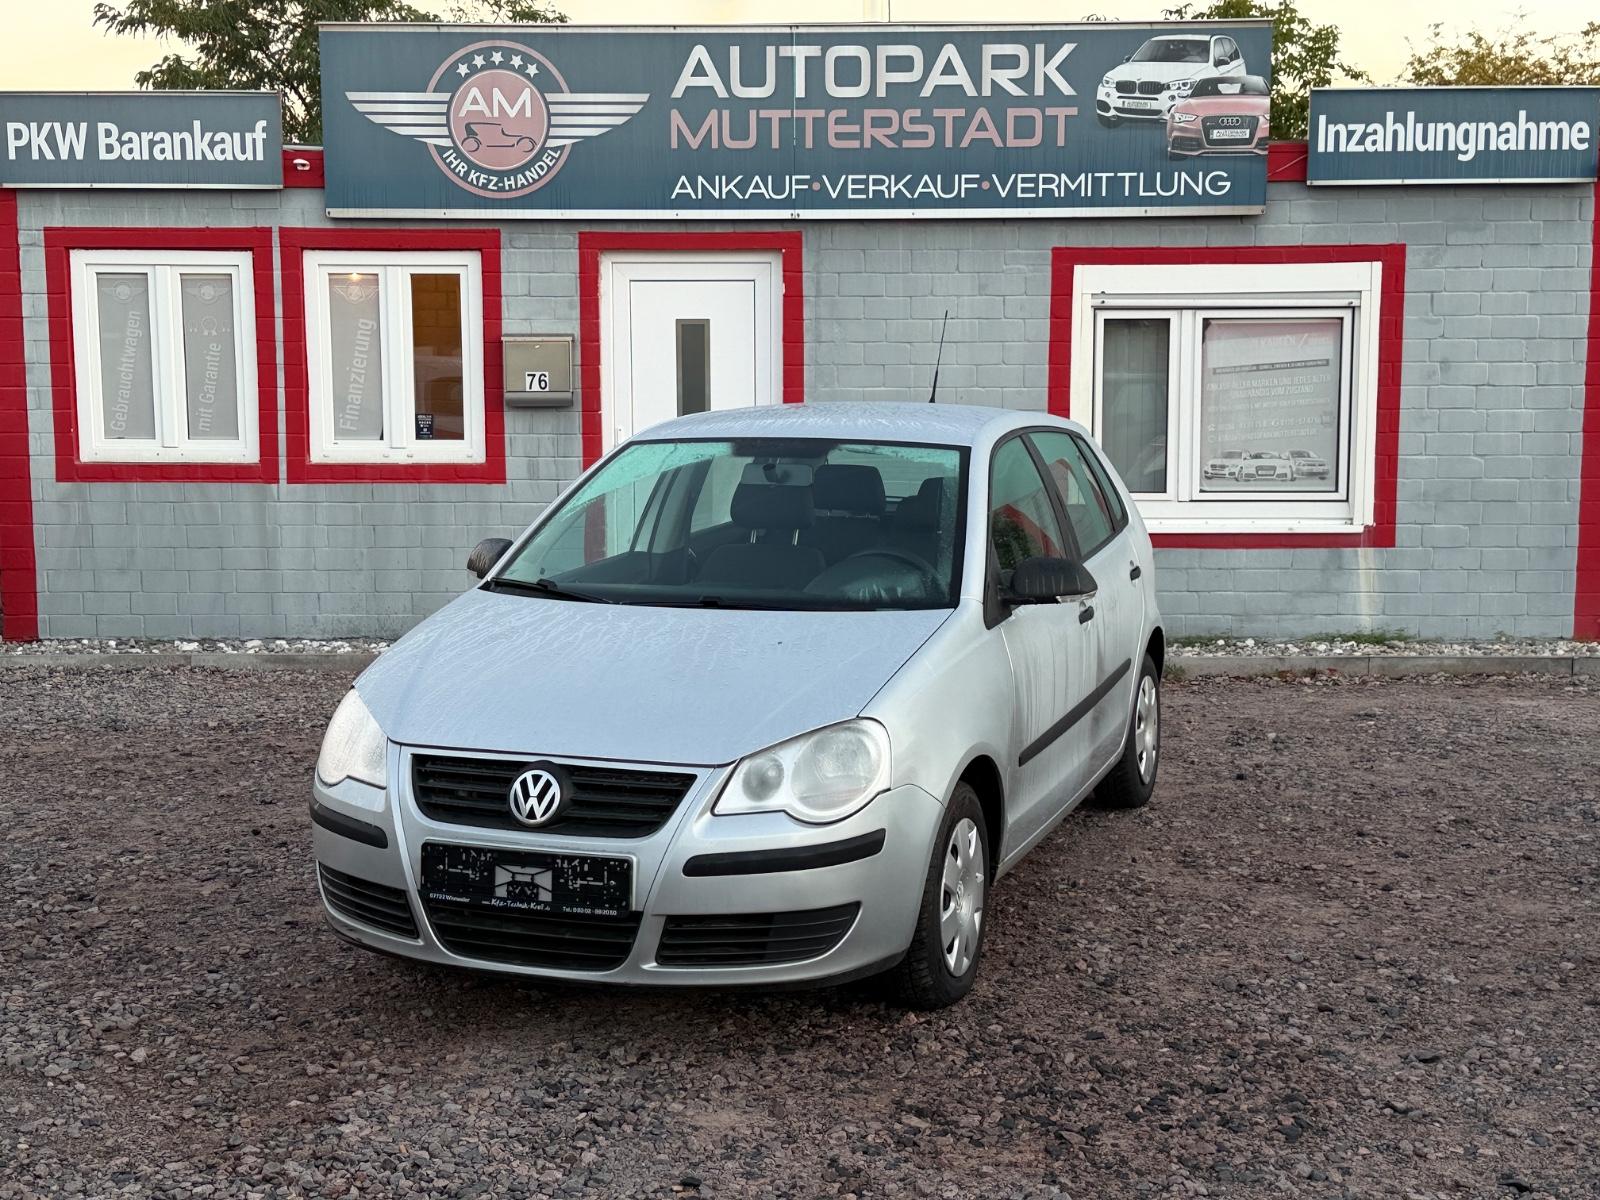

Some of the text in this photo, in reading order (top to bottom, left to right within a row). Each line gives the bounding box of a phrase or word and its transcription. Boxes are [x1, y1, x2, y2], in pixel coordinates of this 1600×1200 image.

[670, 42, 1078, 99] AUTOPARK
[458, 86, 532, 118] AM
[6, 119, 267, 161] PKW Barankauf
[670, 107, 1079, 150] MUTTERSTADT
[1317, 110, 1590, 162] Inzahlungnahme
[442, 149, 561, 190] IHR KFZ-HANDEL
[670, 170, 1232, 200] ANKAUF VERKAUF VERMITTLUNG
[110, 310, 143, 431] Gebrauchtwagen
[195, 343, 222, 432] mit Garantie
[339, 318, 377, 431] Finanzierung
[526, 372, 548, 390] 76
